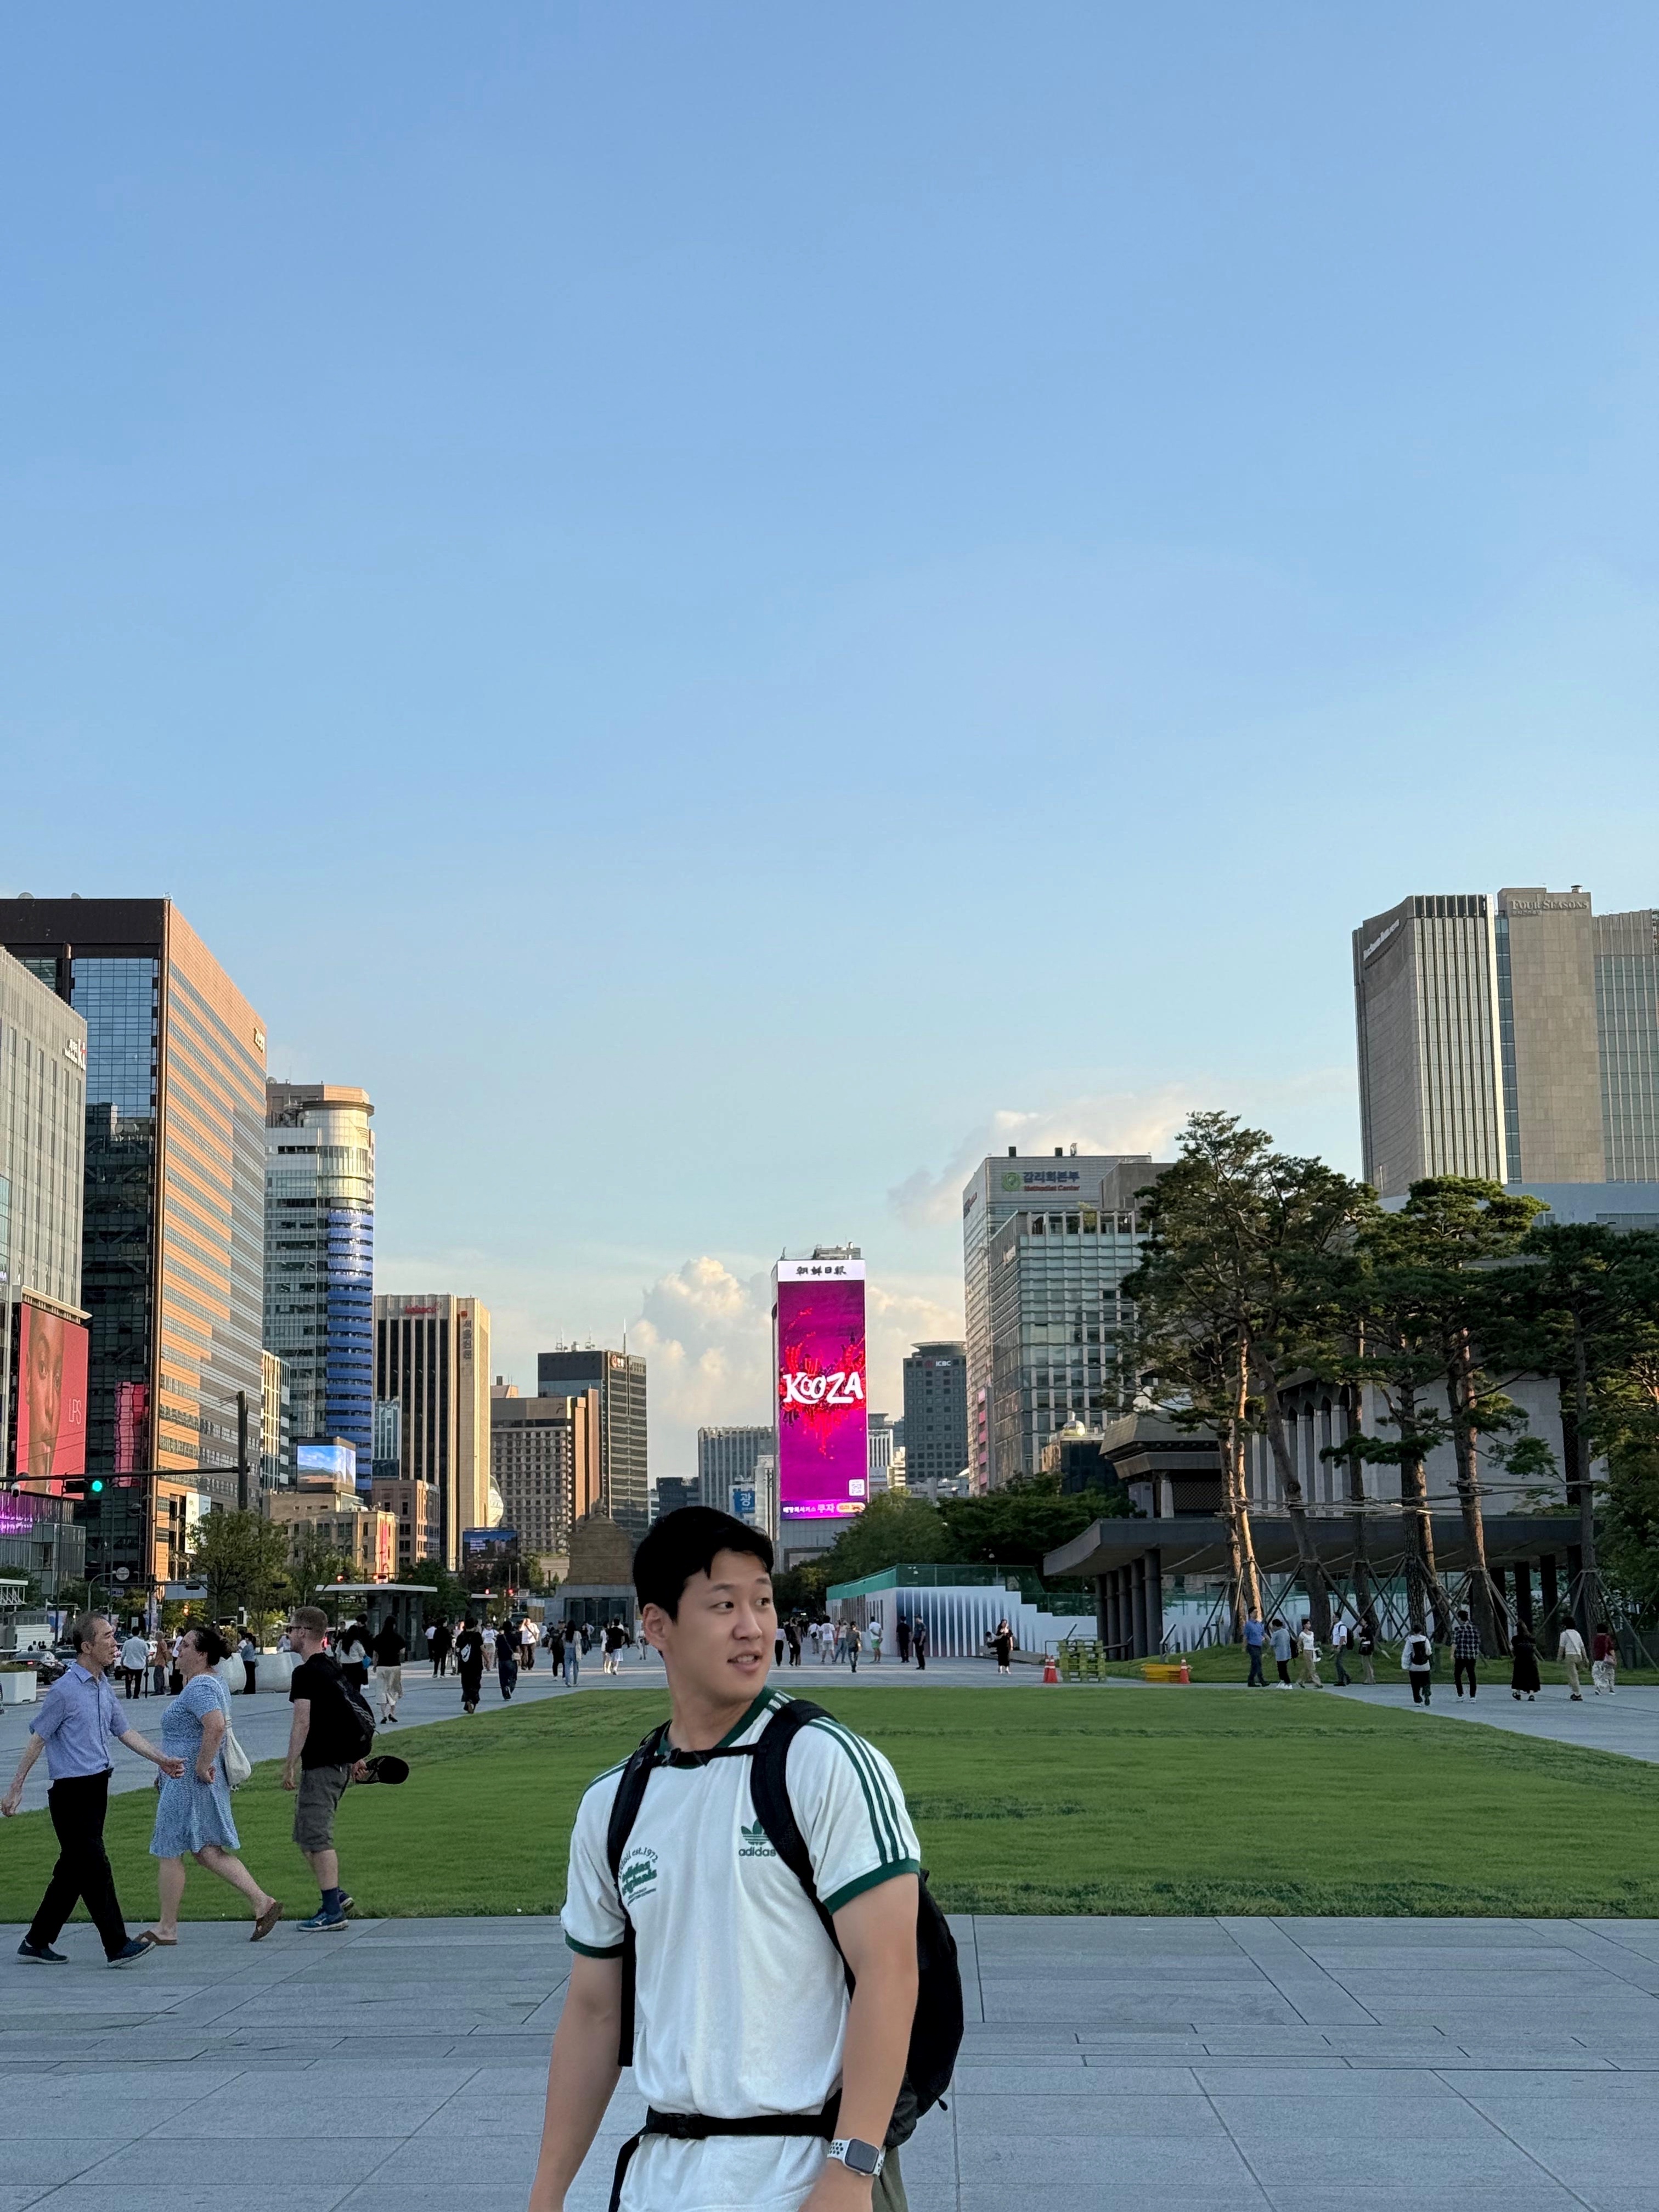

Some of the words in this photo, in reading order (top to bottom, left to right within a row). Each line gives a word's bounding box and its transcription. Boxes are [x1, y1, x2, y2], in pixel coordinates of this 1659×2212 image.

[1511, 900, 1541, 910] FOUR
[1543, 899, 1589, 910] SEASONS
[738, 1847, 776, 1857] adidas
